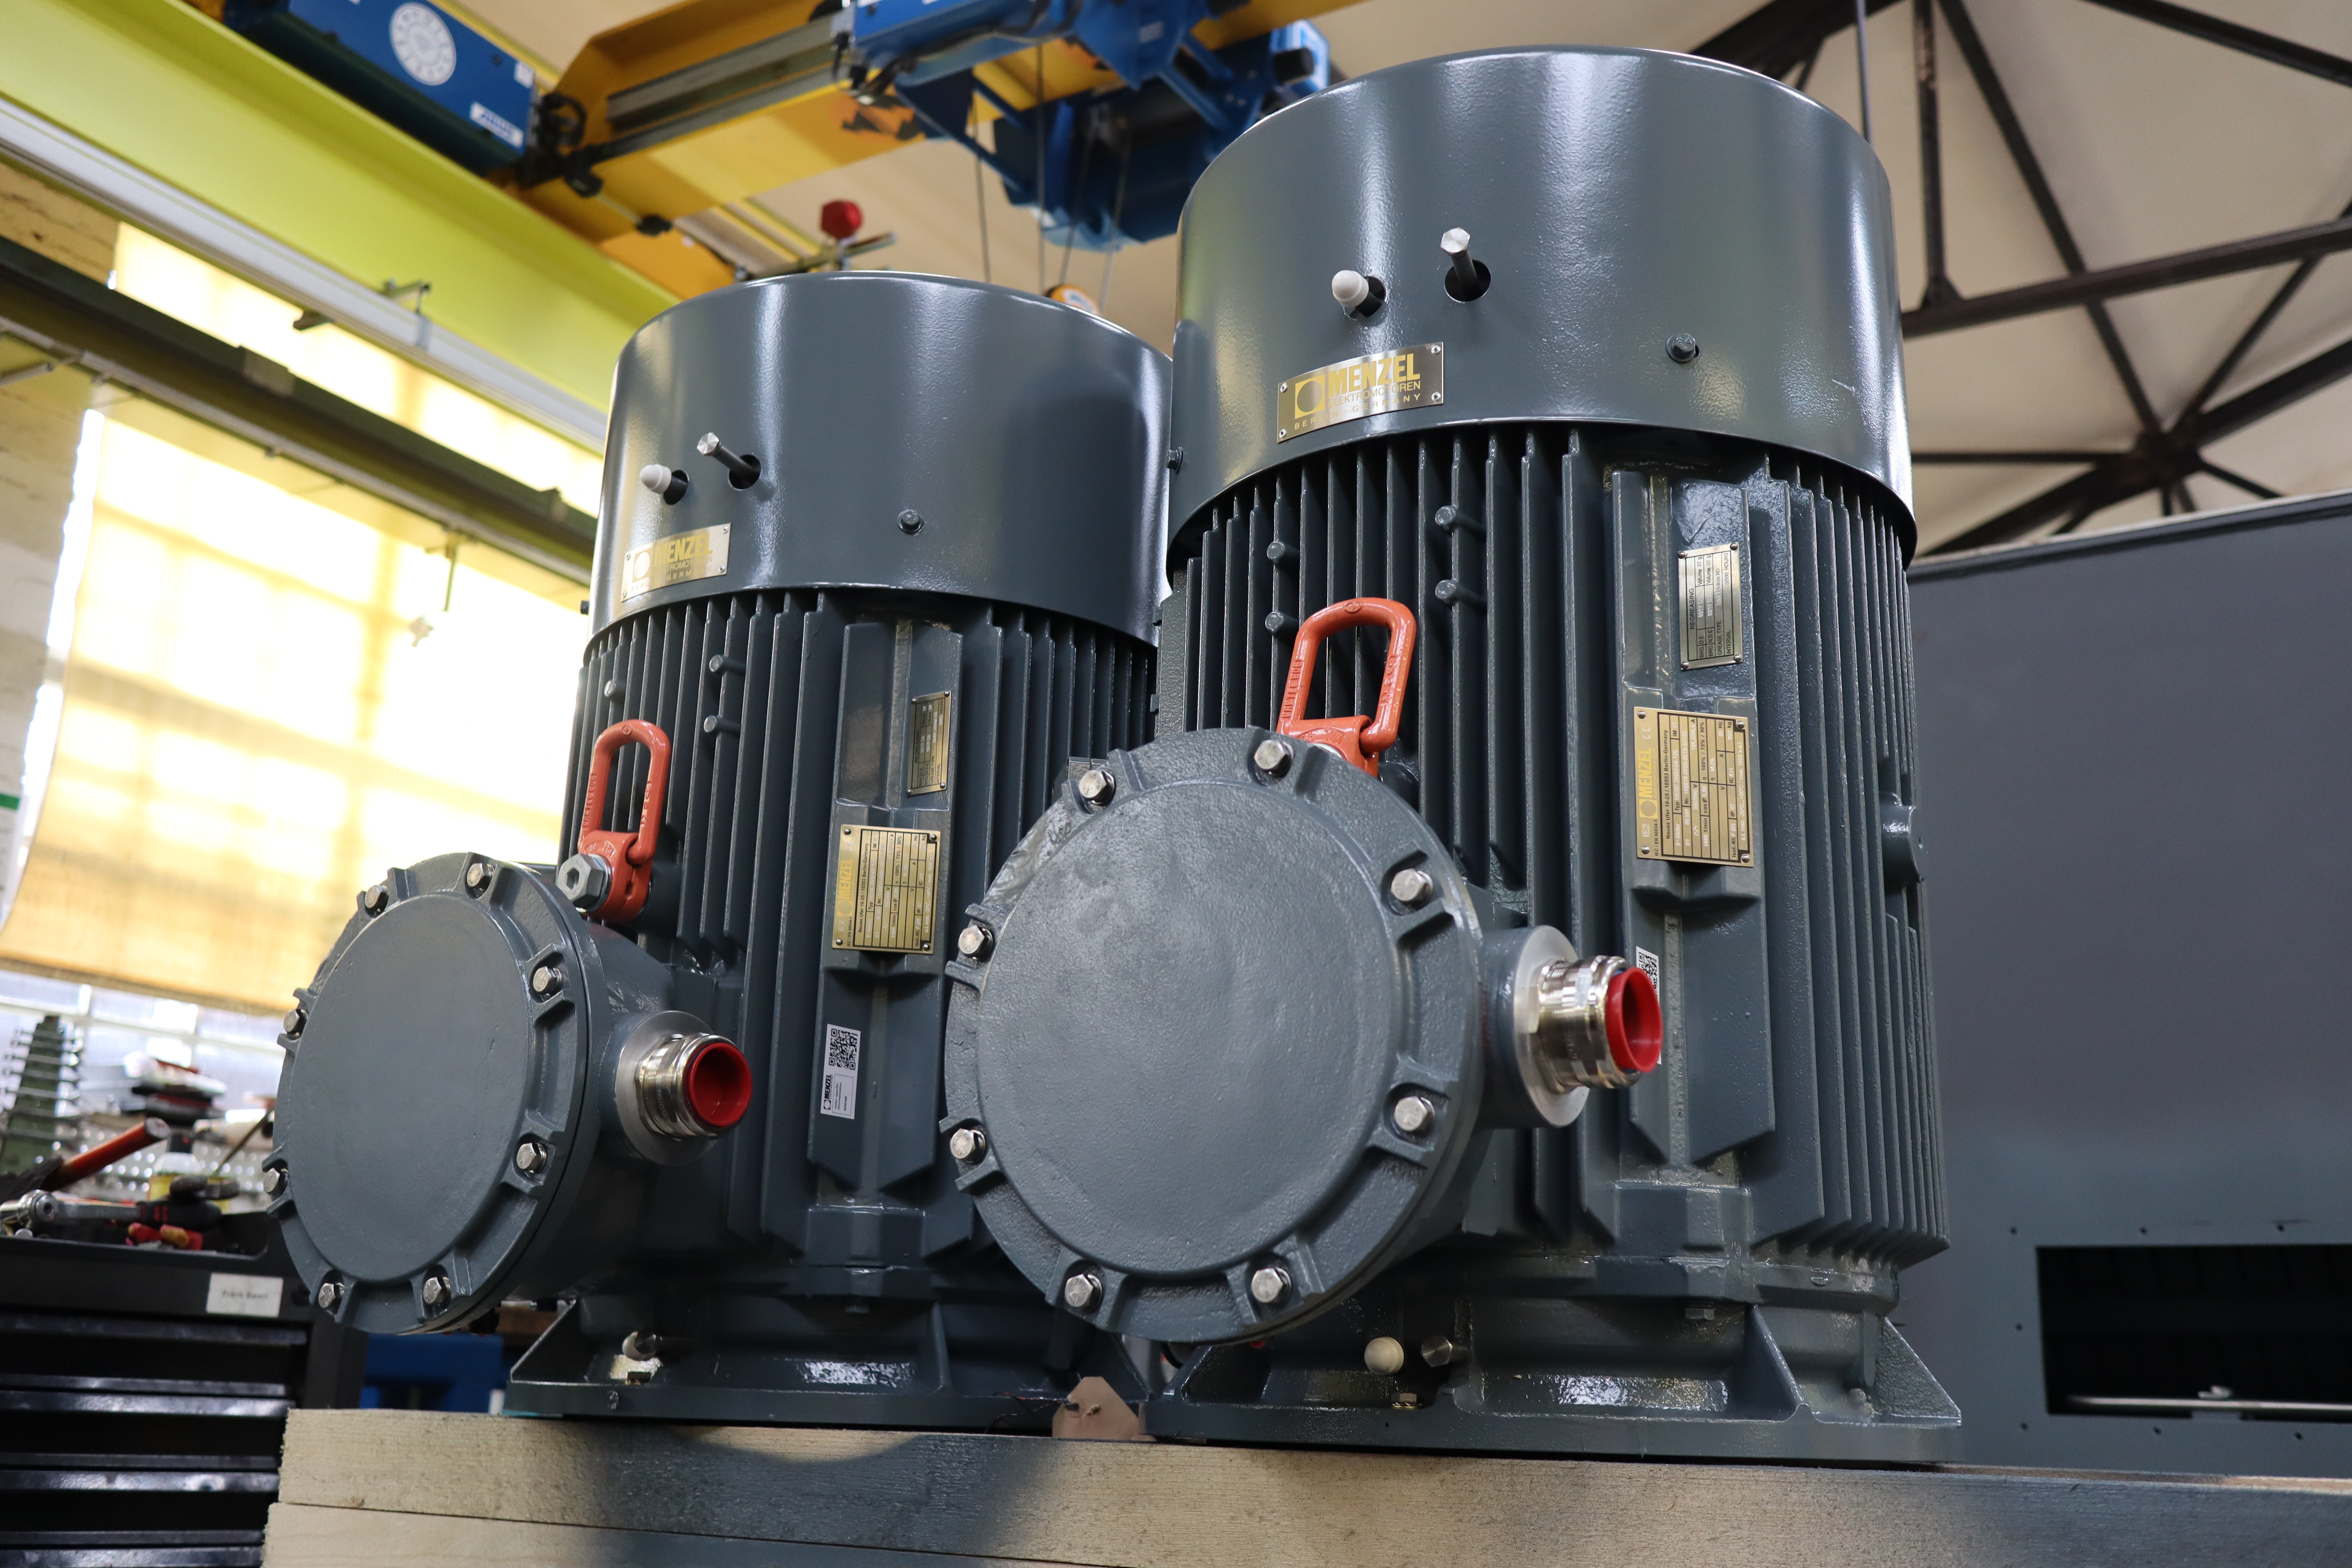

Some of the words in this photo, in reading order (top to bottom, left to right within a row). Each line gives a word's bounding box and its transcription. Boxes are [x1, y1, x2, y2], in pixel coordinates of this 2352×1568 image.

[1328, 354, 1421, 398] MENZEL
[1328, 380, 1421, 408] ELEKTROMOTOREN
[1294, 411, 1338, 430] BERLIN
[1352, 392, 1421, 412] GERMANY
[653, 533, 713, 568] MENZEL
[1639, 748, 1652, 799] MENZEL
[1641, 823, 1650, 837] IE2
[838, 858, 852, 900] MENZEL
